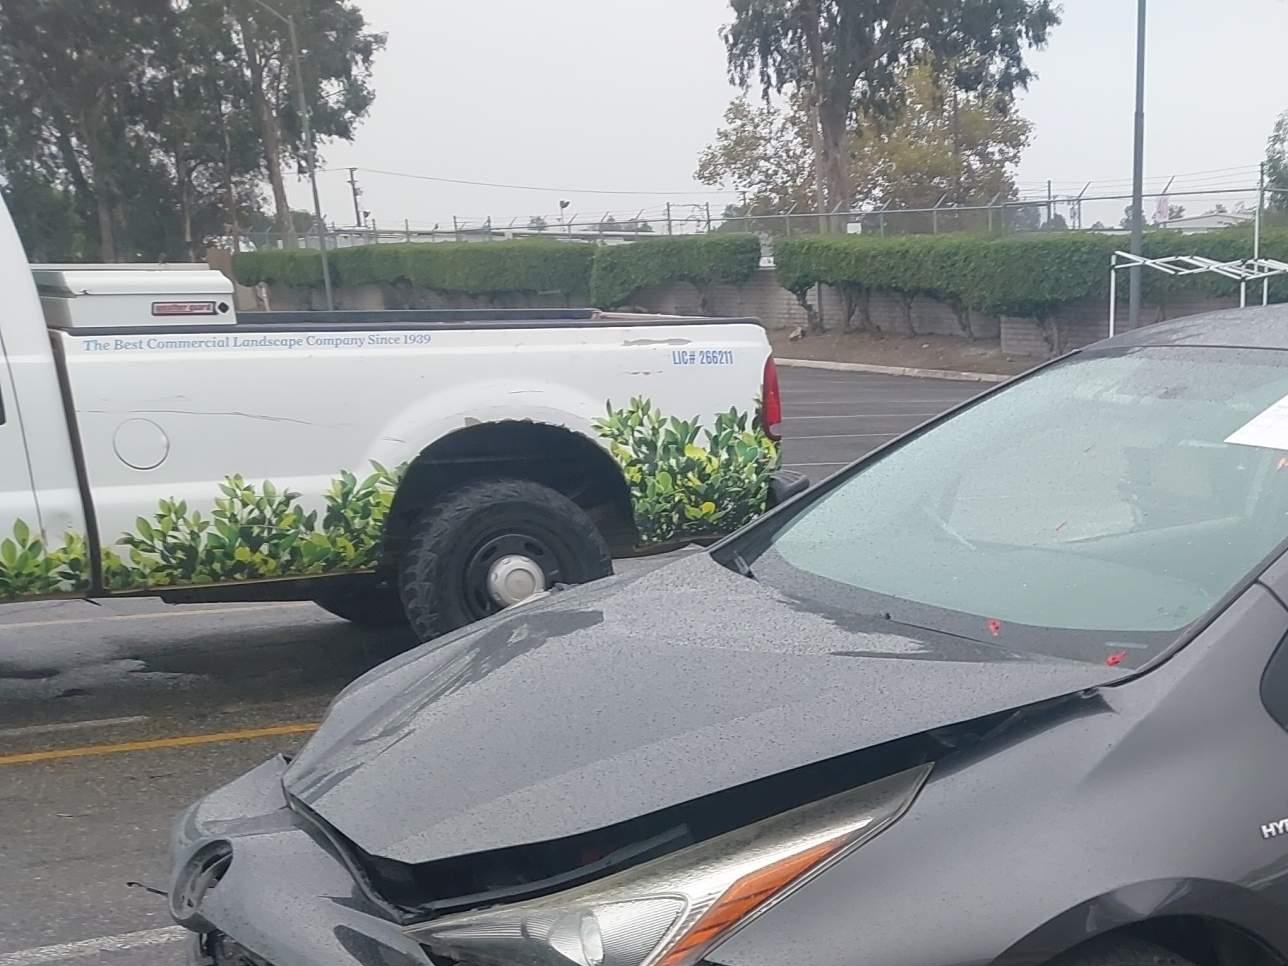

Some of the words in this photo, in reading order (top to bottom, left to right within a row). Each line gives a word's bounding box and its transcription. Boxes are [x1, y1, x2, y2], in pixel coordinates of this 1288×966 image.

[83, 339, 110, 351] The
[114, 339, 143, 351] Best
[147, 337, 230, 350] Commercial
[233, 335, 304, 349] Landscape
[306, 335, 366, 348] Company
[367, 334, 401, 346] Since
[403, 334, 432, 345] 1939
[672, 350, 696, 365] LIC#
[699, 350, 734, 365] 266211
